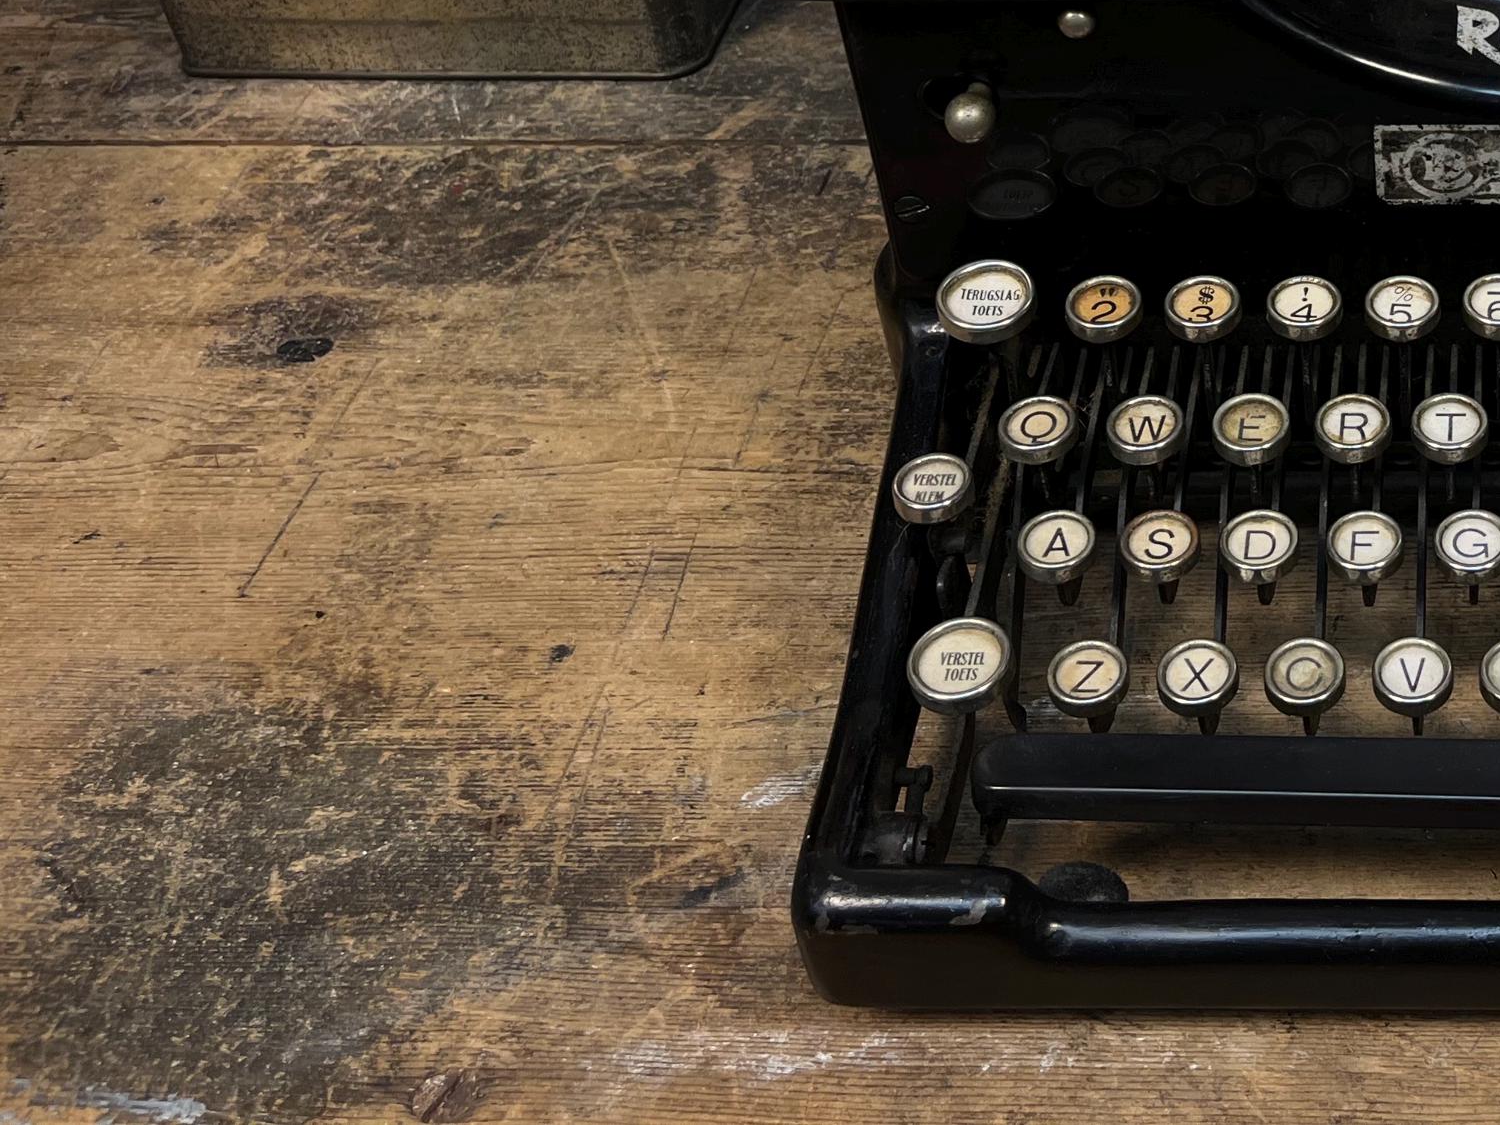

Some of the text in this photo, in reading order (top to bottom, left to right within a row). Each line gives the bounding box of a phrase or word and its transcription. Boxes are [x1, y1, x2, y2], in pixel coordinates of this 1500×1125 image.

[961, 288, 1021, 302] TERUGSLAG
[972, 305, 1004, 317] TOETS
[1090, 300, 1117, 323] 2
[1290, 303, 1318, 323] 4
[1389, 303, 1412, 323] 5
[1020, 411, 1057, 443] Q
[1128, 414, 1167, 443] W
[1237, 414, 1266, 442] E
[1338, 412, 1370, 443] R
[1436, 413, 1466, 442] T
[913, 473, 957, 486] VERSTEL
[1042, 527, 1071, 558] A
[1144, 528, 1175, 560] S
[1243, 530, 1276, 560] D
[1350, 530, 1380, 561] F
[1452, 528, 1489, 558] G
[940, 651, 985, 666] VERSTEL
[944, 668, 979, 681] TOETS
[1070, 660, 1104, 693] Z
[1180, 658, 1215, 692] X
[1286, 657, 1322, 692] C
[1400, 657, 1425, 693] V
